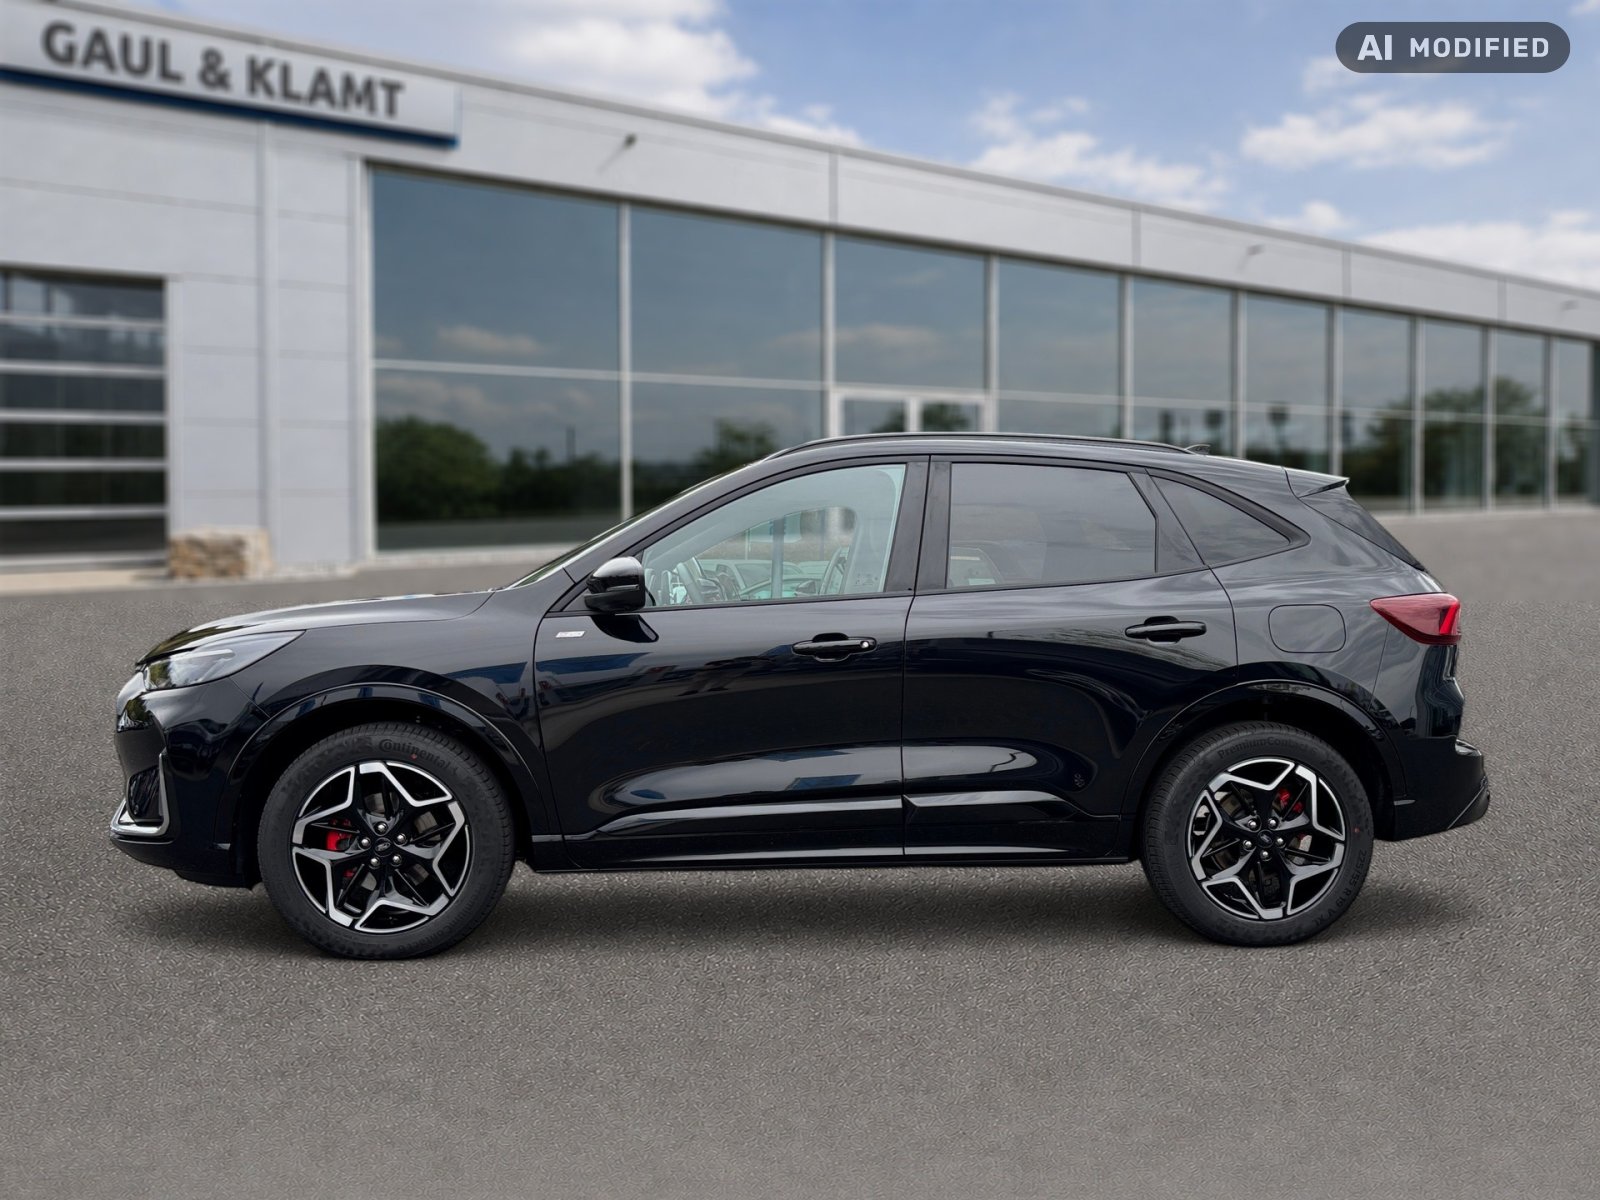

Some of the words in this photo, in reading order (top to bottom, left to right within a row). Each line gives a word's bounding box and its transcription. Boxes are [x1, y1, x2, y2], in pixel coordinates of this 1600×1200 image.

[41, 20, 183, 84] GAUL
[199, 47, 231, 91] &
[246, 54, 405, 119] KLAMT
[379, 738, 451, 769] Continental
